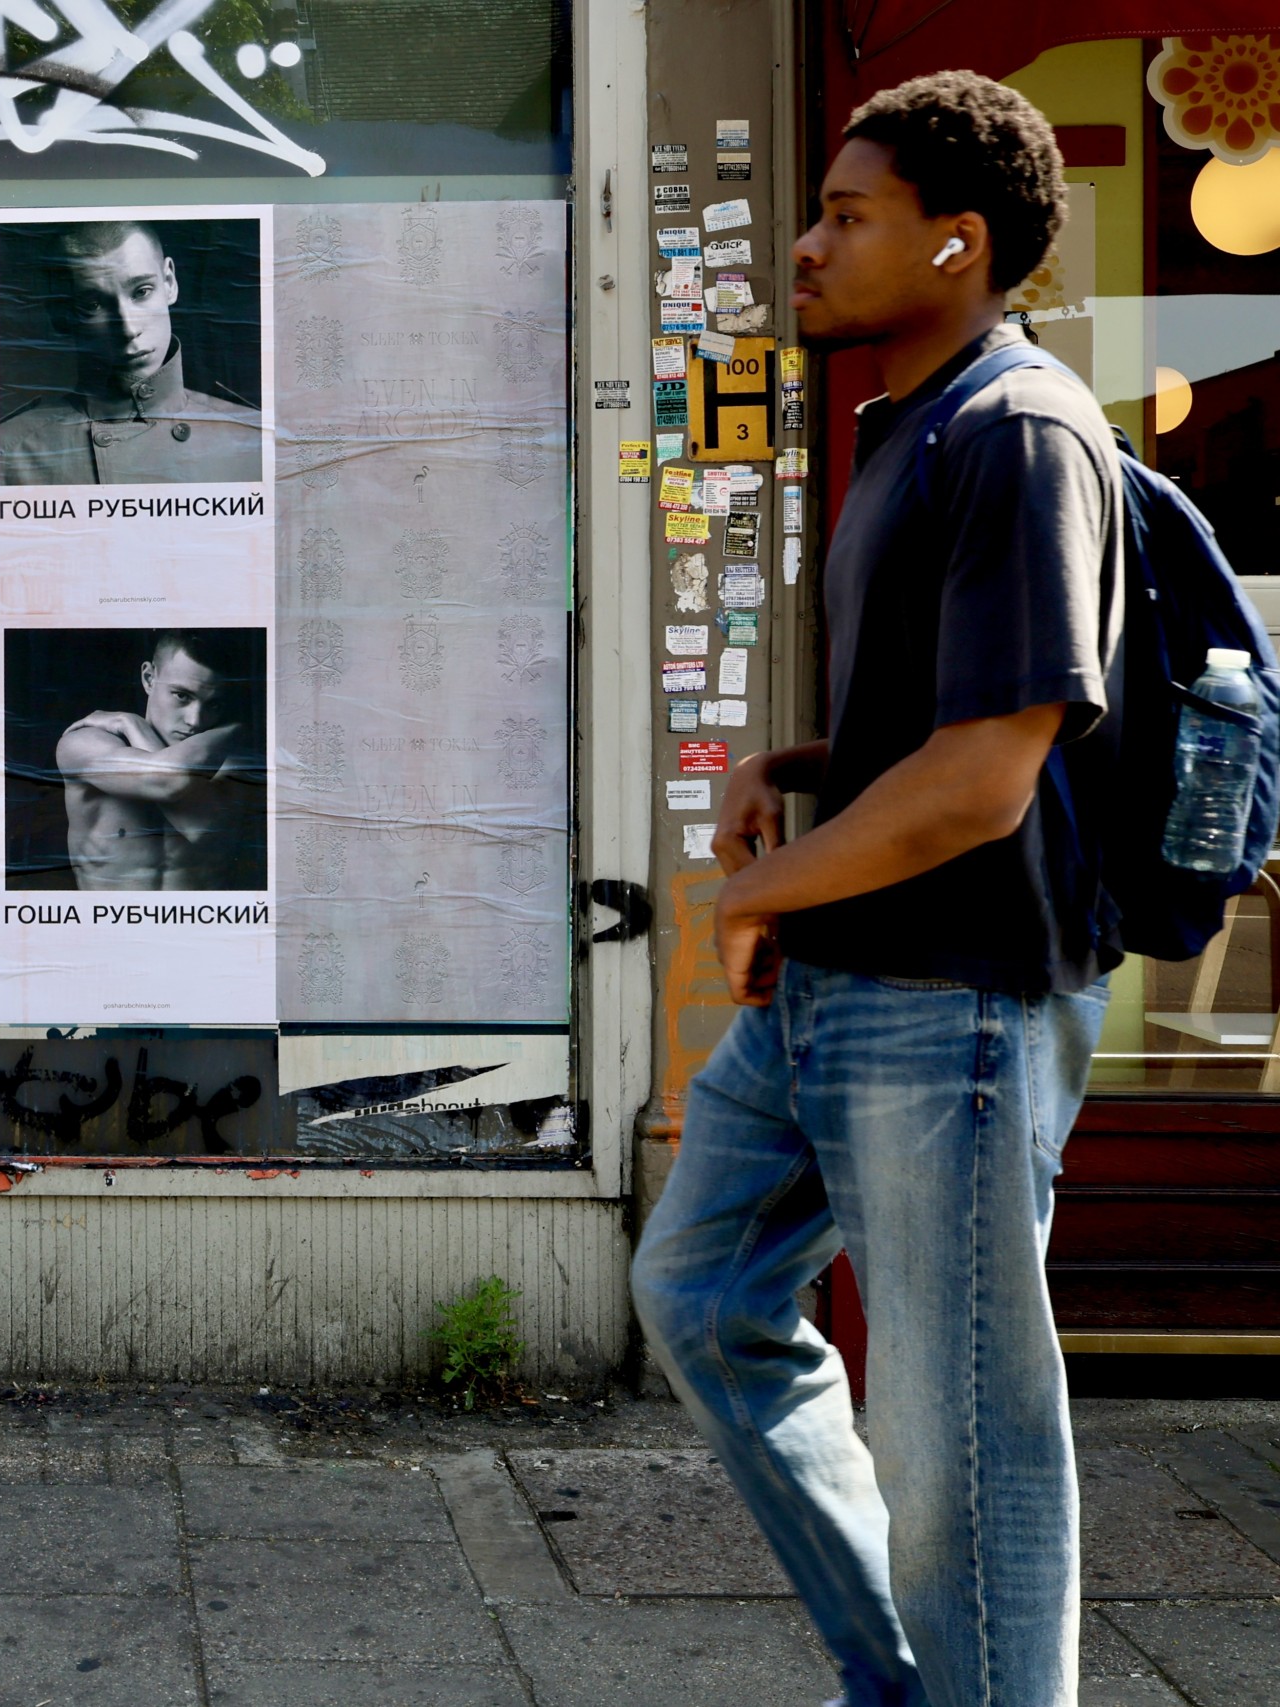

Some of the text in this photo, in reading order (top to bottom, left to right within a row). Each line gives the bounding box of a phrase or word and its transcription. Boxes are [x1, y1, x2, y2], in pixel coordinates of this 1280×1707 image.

[663, 186, 688, 194] COBRA
[711, 241, 743, 251] QUICK
[361, 331, 480, 347] SLEEP TOKEN
[727, 358, 760, 376] 100
[363, 378, 480, 408] EVEN IN
[657, 381, 685, 392] JD
[356, 410, 486, 440] ARCADIA
[736, 424, 749, 440] 3
[0, 492, 264, 519] ГОША РУБЧИНСКИЙ
[668, 514, 701, 524] Skyline
[668, 626, 701, 635] Skyline
[361, 738, 480, 753] SLEEP TOKEN
[364, 785, 480, 813] EVEN IN
[357, 814, 489, 842] ARCADIA
[4, 901, 269, 924] ГОША РУБЧИНСКИЙ
